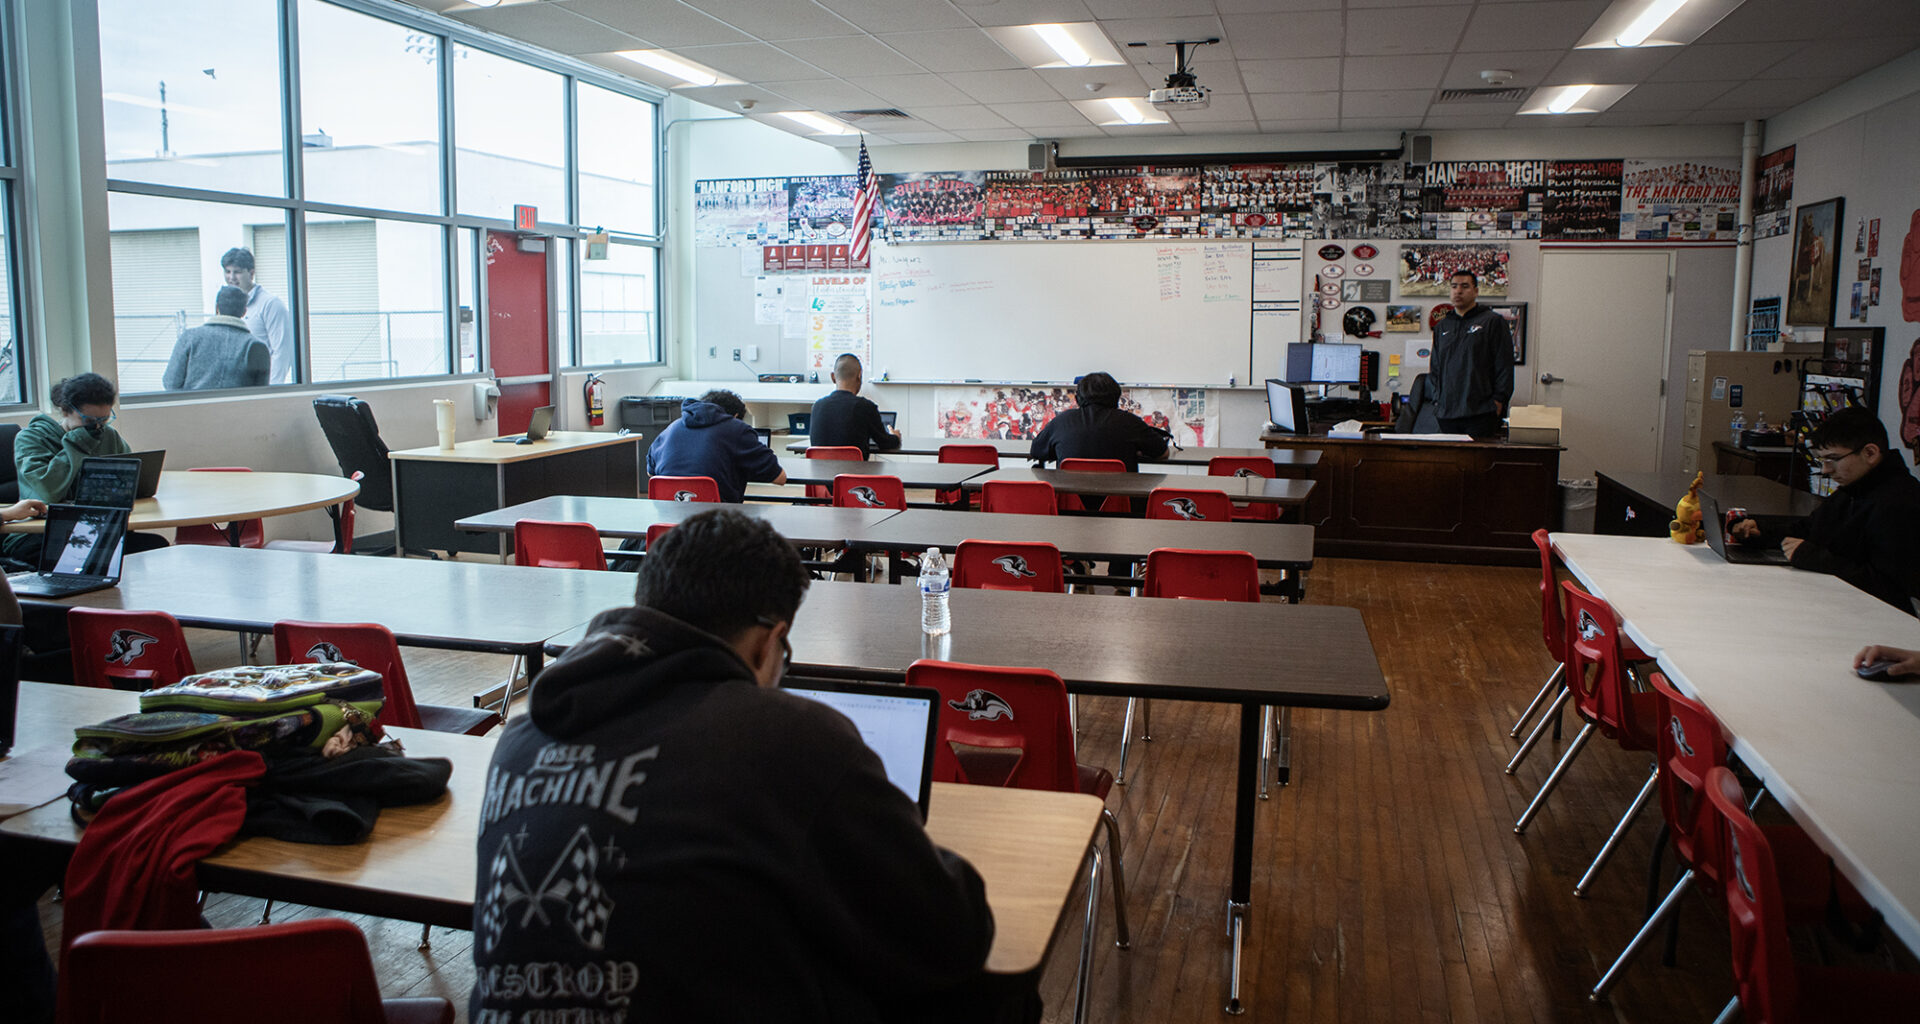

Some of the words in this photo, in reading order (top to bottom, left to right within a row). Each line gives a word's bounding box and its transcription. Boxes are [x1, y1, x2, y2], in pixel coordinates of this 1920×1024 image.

[987, 172, 1032, 180] BULLPUPS
[1043, 171, 1088, 179] FOOTBALL
[1425, 161, 1501, 184] HANFORD
[1505, 161, 1544, 184] HIGH
[1548, 168, 1572, 176] PLAY
[1574, 168, 1600, 176] FAST.
[1598, 162, 1623, 177] HIGH
[895, 179, 975, 197] BULLPUPS
[1548, 178, 1572, 187] PLAY
[1574, 177, 1620, 186] PHYSICAL.
[1547, 189, 1571, 197] PLAY
[1573, 189, 1620, 197] FEARLESS.
[1626, 186, 1650, 198] THE
[1652, 185, 1712, 198] HANFORD
[519, 206, 537, 229] EXIT
[1128, 207, 1154, 216] EARN
[1016, 216, 1035, 225] SAY
[1036, 216, 1057, 225] WIN
[812, 277, 850, 286] LEVELS
[853, 277, 867, 286] OF
[528, 743, 597, 774] LOSER
[480, 745, 660, 838] MACHINE
[478, 961, 640, 1005] DESTROY
